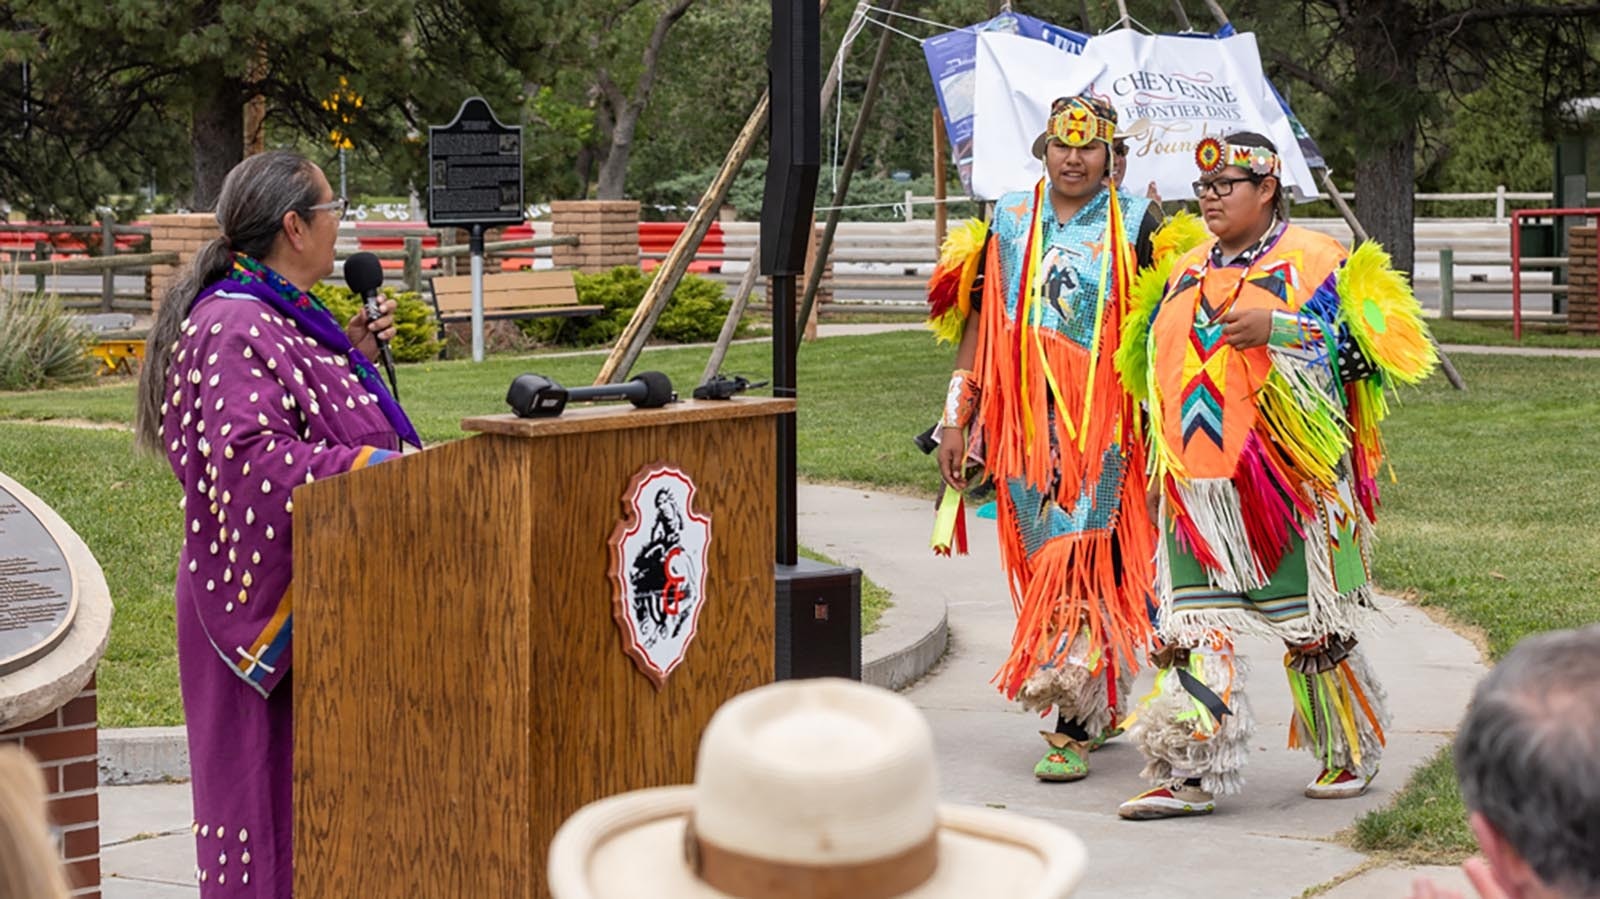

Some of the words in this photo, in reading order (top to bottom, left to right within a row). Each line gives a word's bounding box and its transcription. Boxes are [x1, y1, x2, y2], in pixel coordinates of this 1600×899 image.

[1113, 71, 1237, 103] CHEYENNE
[1125, 103, 1203, 119] FRONTIER
[1206, 105, 1241, 120] DAYS
